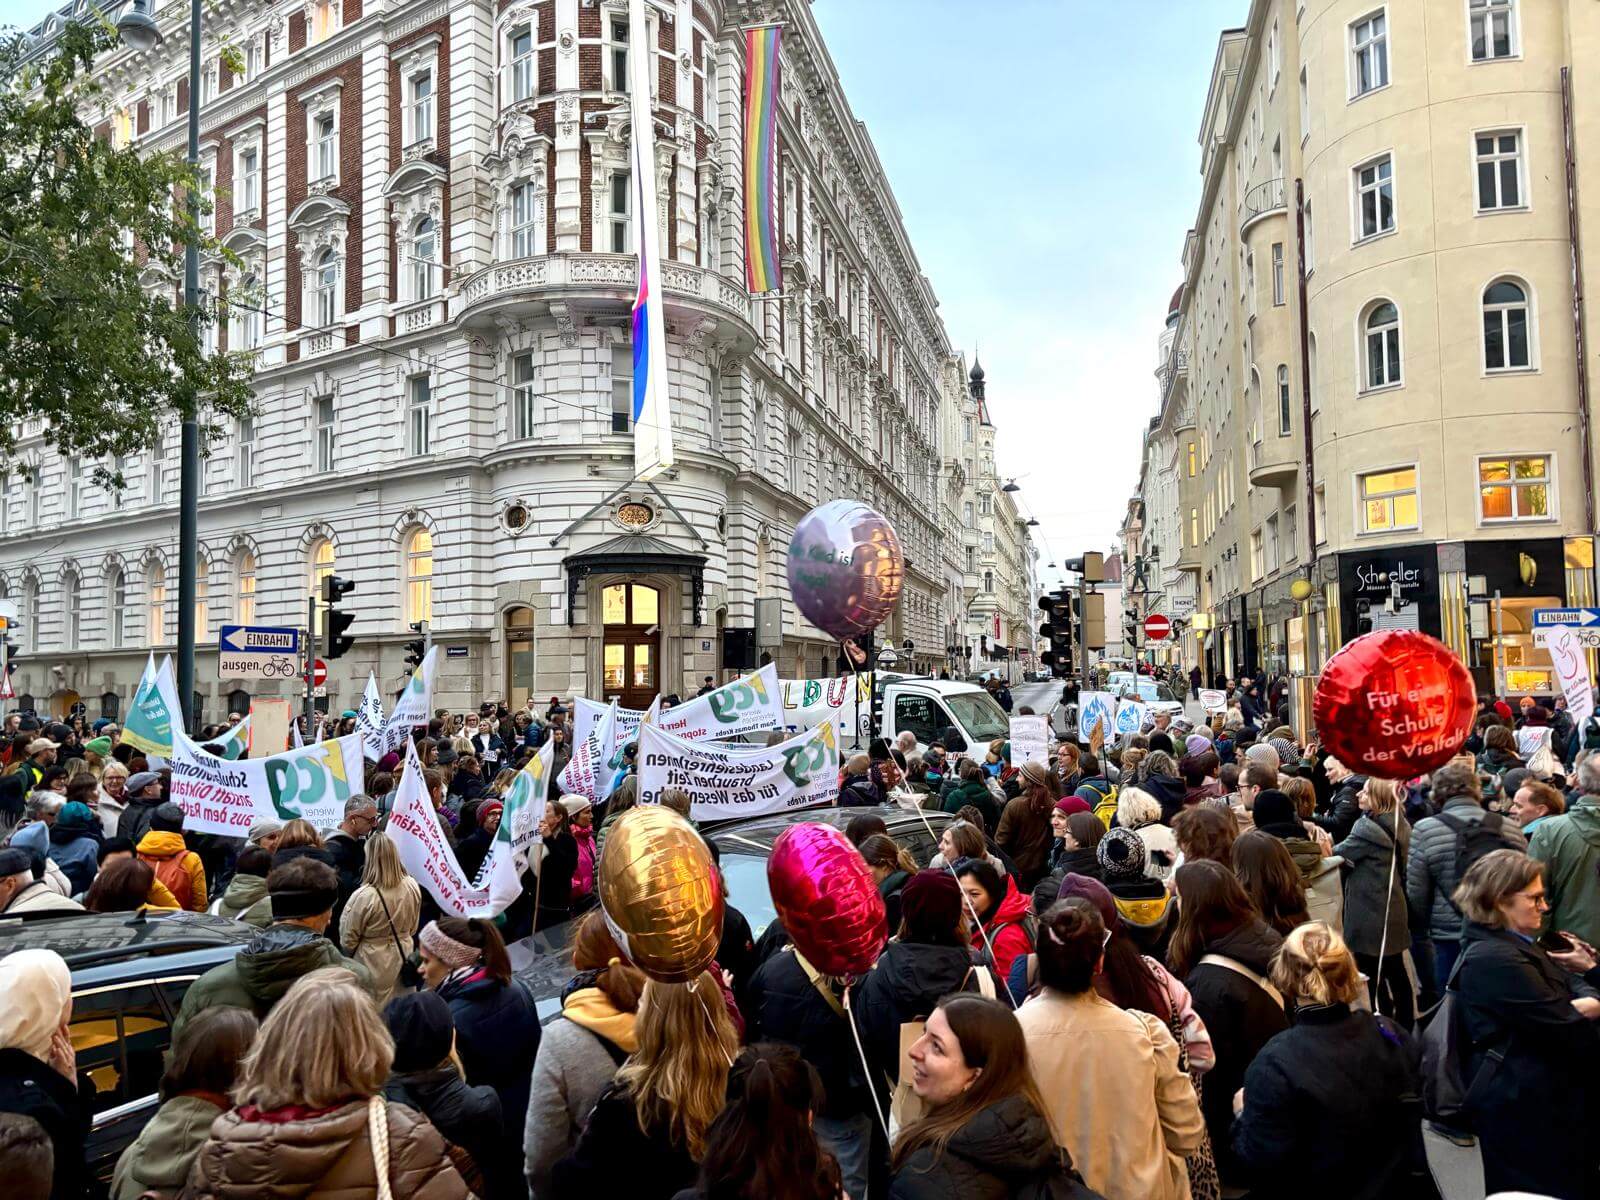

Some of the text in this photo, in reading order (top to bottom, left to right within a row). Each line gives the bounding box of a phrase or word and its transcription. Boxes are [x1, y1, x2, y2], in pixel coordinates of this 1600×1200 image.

[1541, 613, 1580, 622] EINBAHN
[246, 633, 290, 646] EINBAHN
[222, 661, 262, 673] ausgen.
[784, 671, 872, 710] LDUN
[1366, 691, 1400, 710] Für
[1381, 713, 1444, 736] Schule
[1362, 727, 1464, 762] der Vielfalt
